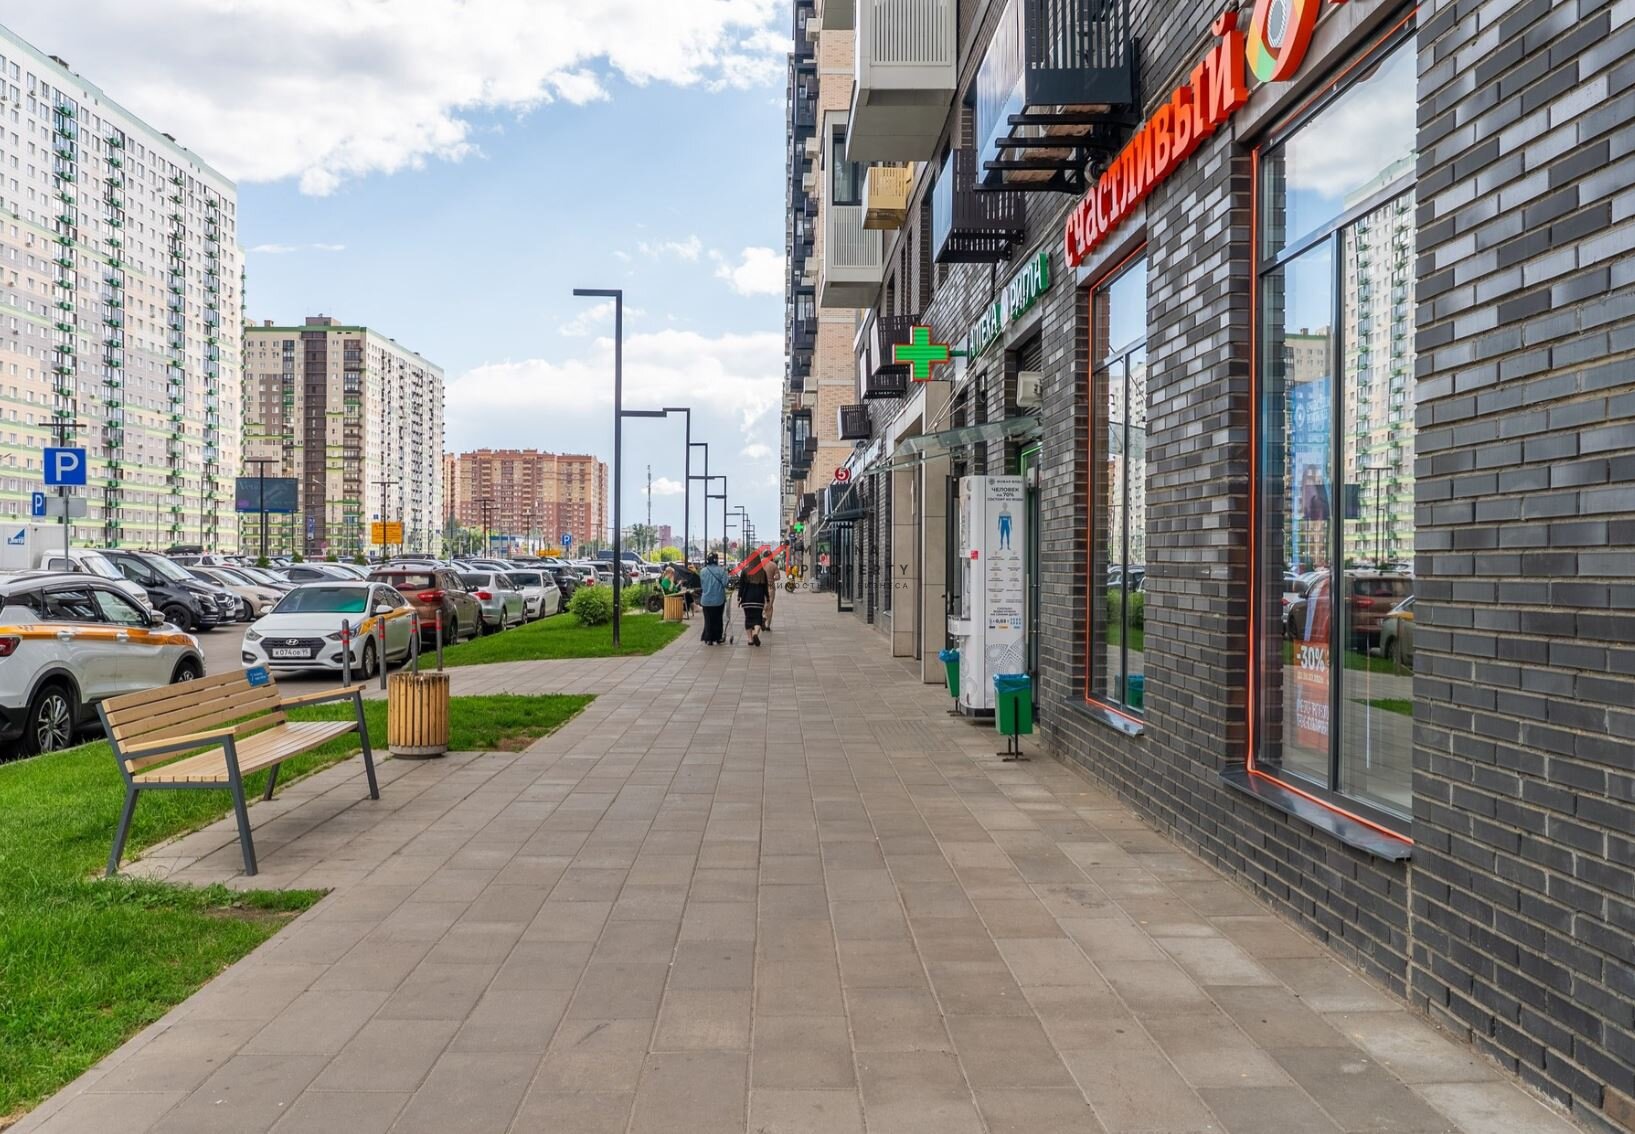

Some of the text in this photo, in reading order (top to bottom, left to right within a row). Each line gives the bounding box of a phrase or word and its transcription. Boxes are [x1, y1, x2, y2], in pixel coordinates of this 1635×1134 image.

[969, 303, 998, 357] АПТЕКА
[55, 451, 79, 482] P
[34, 494, 43, 515] P
[1296, 645, 1325, 673] -30%
